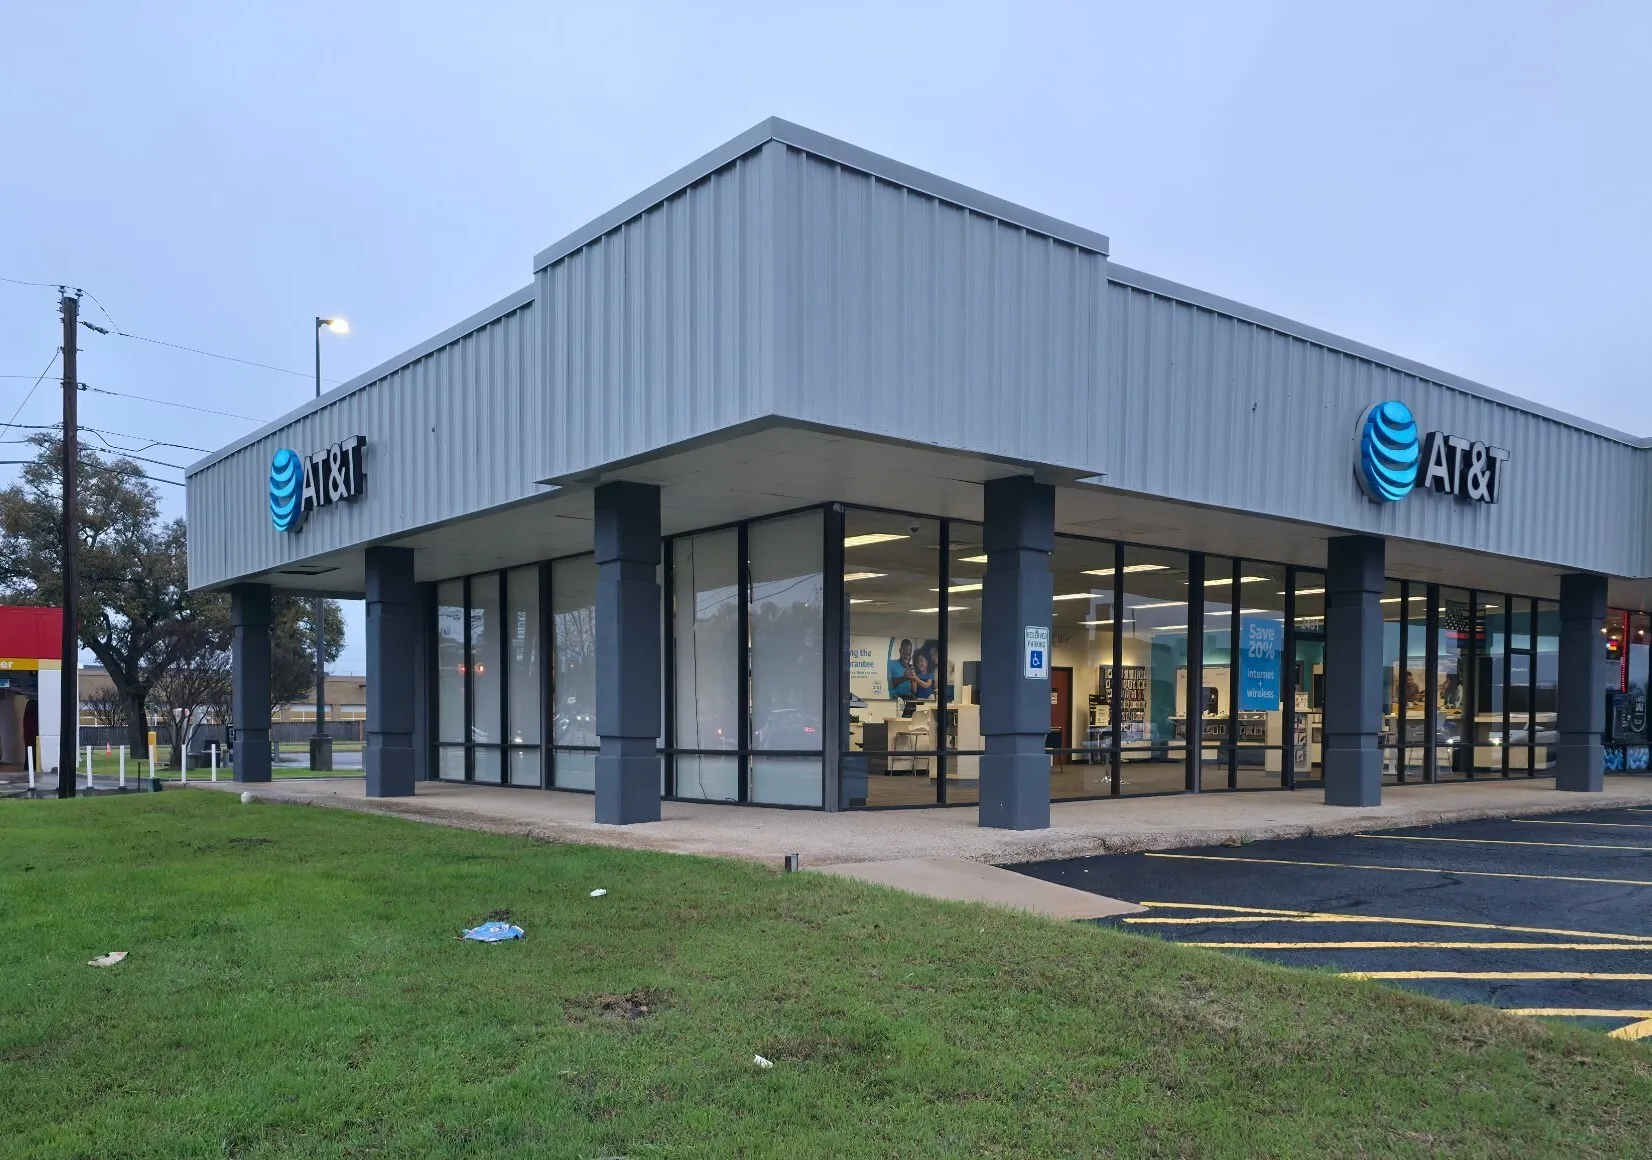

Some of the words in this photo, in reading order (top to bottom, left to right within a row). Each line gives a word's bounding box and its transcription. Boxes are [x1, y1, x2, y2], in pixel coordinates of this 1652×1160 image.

[301, 435, 363, 512] AT&T
[1423, 431, 1510, 504] AT&T
[1026, 631, 1047, 639] RESERVED
[1249, 624, 1275, 640] Save
[1248, 641, 1275, 659] 20%
[1247, 668, 1274, 679] internet
[1247, 688, 1274, 698] wireless
